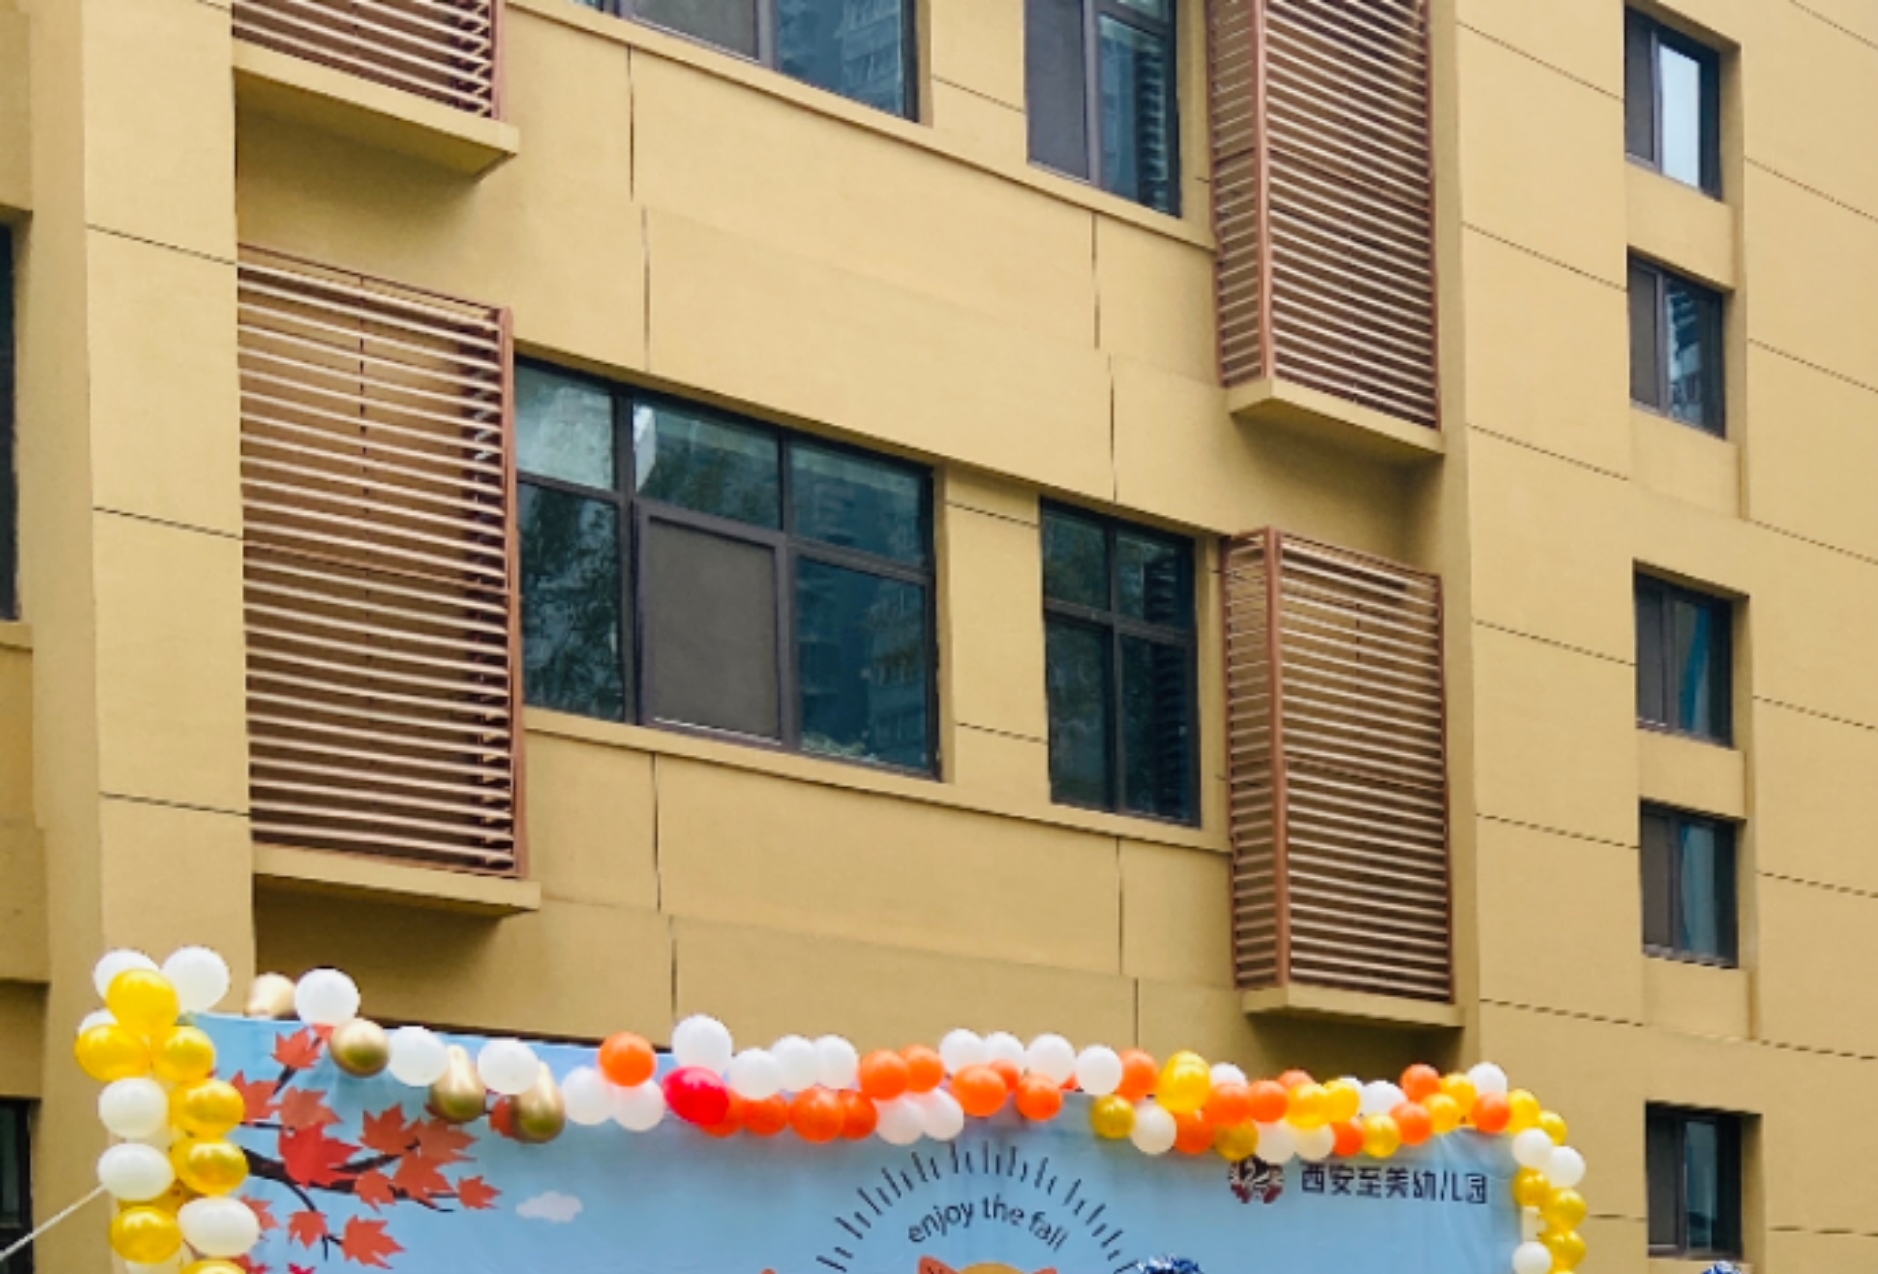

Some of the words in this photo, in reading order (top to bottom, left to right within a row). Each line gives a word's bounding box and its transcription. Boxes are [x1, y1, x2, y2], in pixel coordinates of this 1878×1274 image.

[1301, 1161, 1487, 1204] 西安至美幼儿园
[908, 1202, 974, 1243] enjoy
[981, 1193, 1025, 1227] the
[1028, 1211, 1069, 1252] fall
